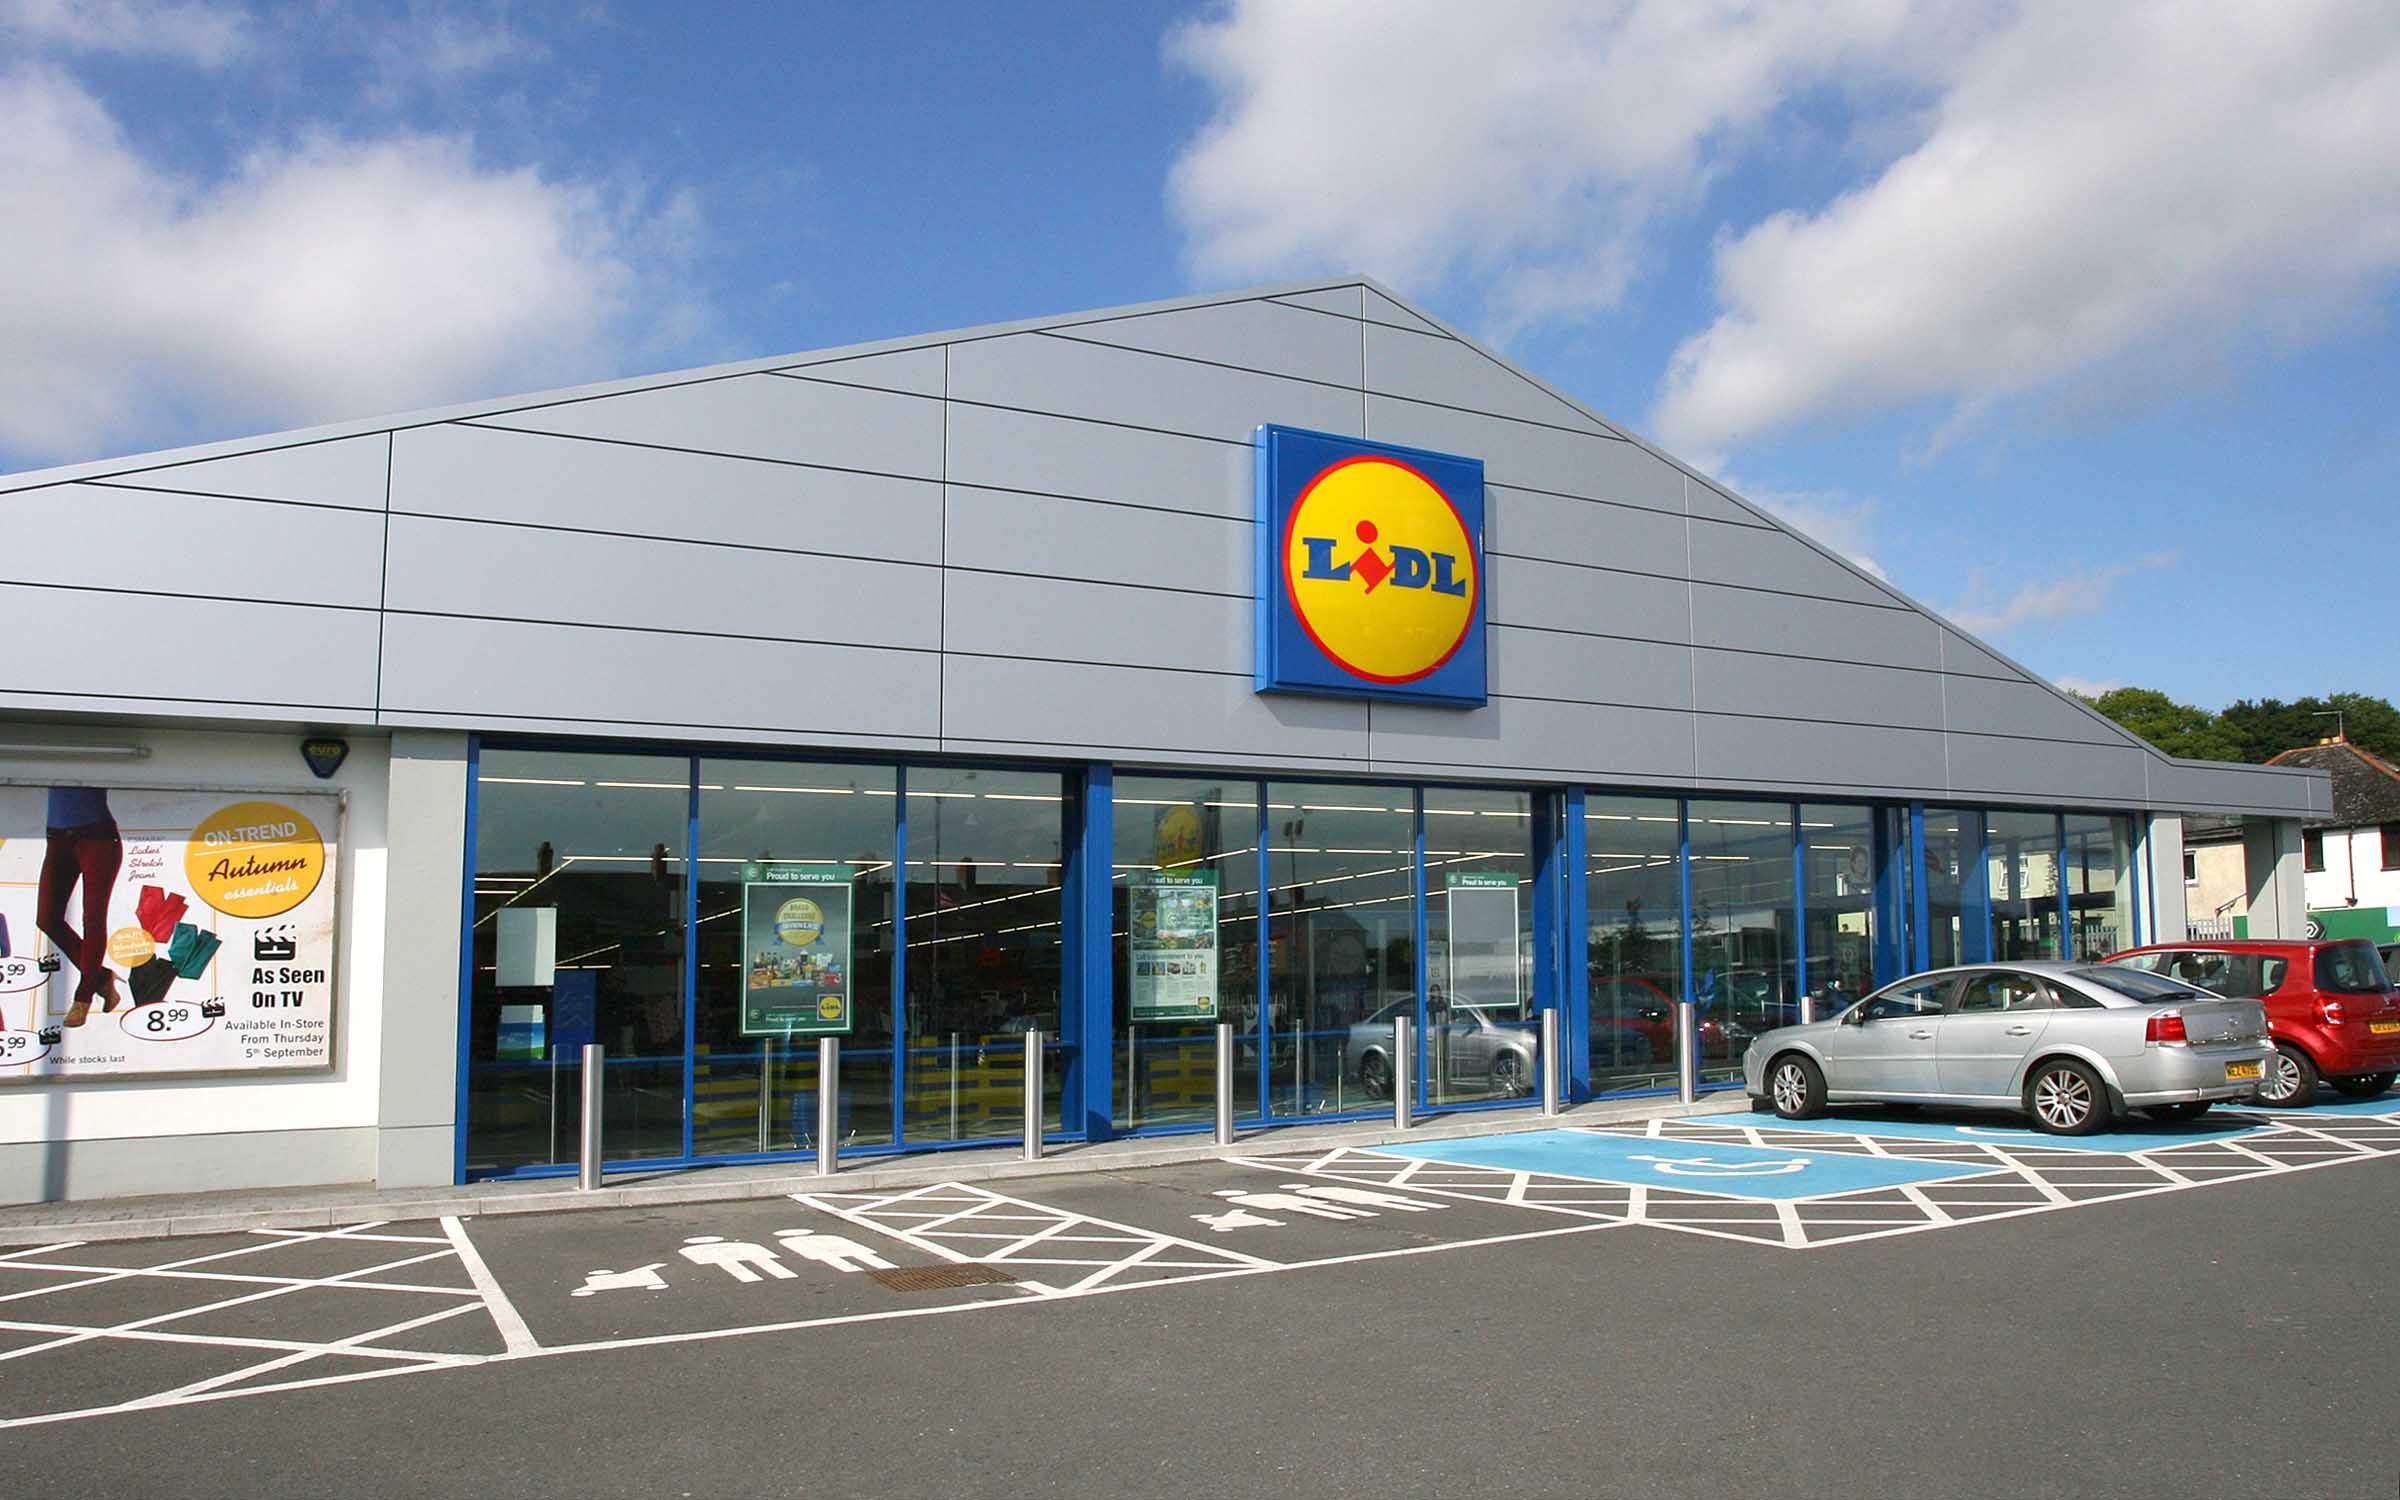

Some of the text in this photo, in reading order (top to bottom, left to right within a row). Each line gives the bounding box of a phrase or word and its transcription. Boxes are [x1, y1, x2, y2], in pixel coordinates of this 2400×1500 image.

[204, 822, 297, 847] ON-TREND
[208, 855, 307, 881] Autumn
[766, 872, 790, 880] Proud
[820, 874, 835, 882] you
[224, 877, 298, 900] essentials
[0, 964, 25, 984] .99
[252, 967, 325, 984] As Seen
[252, 991, 303, 1008] On TV
[225, 1018, 325, 1031] Available In-Store
[241, 1032, 324, 1044] From Thursday
[0, 1037, 26, 1057] .99
[264, 1047, 324, 1059] September
[50, 1055, 125, 1065] While stocks last
